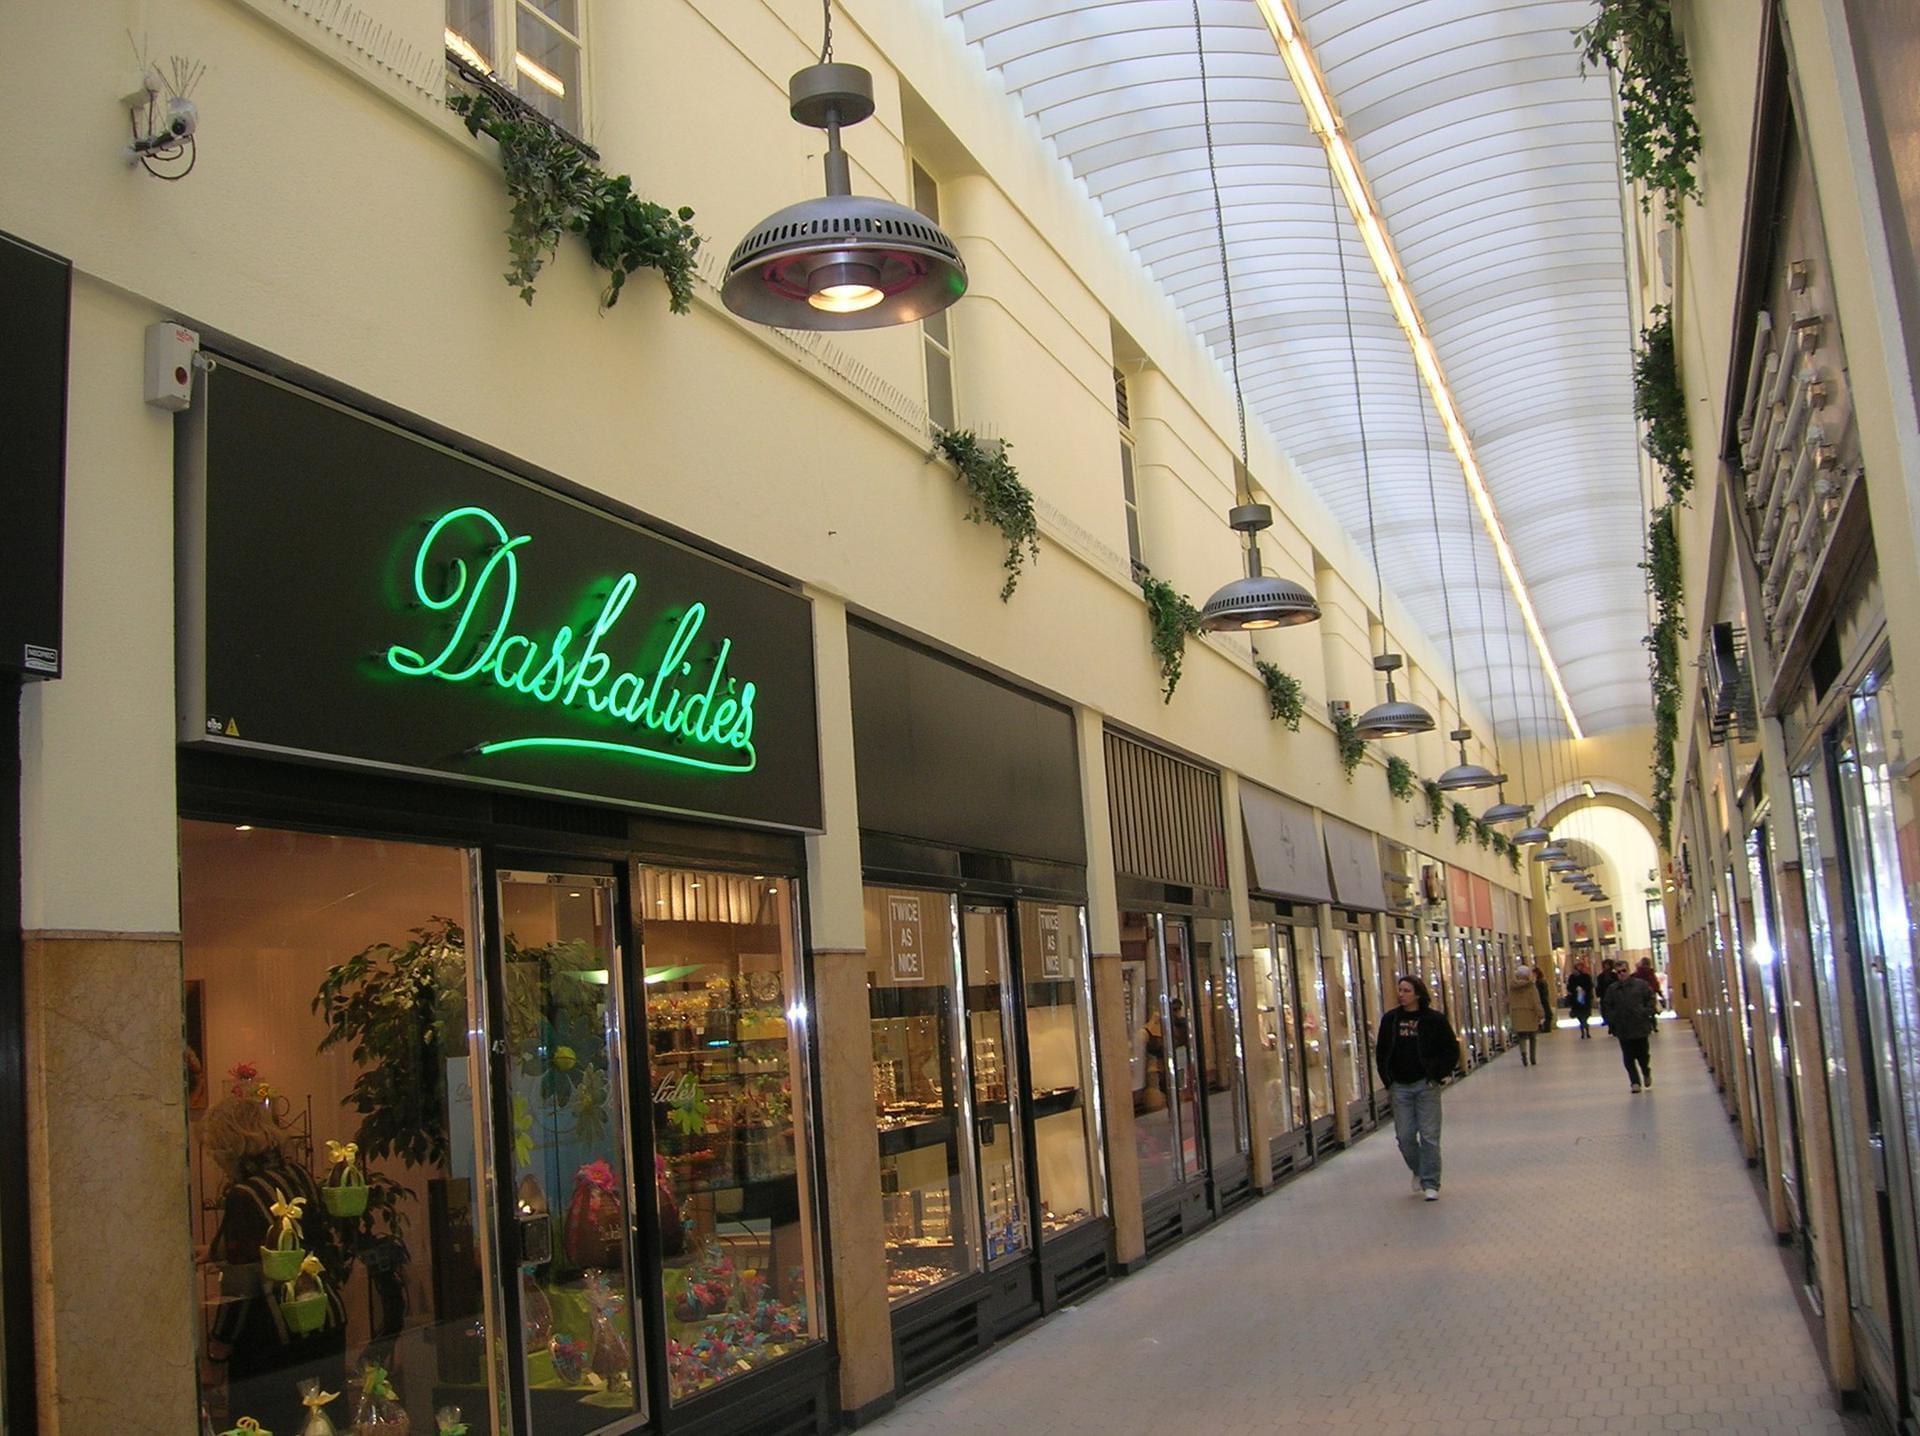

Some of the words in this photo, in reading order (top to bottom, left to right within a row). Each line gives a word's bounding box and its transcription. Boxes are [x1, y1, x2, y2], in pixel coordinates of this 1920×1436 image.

[891, 902, 918, 921] TWICE
[1040, 914, 1059, 930] TWICE
[901, 928, 913, 947] AS
[1047, 935, 1056, 950] AS
[898, 953, 918, 972] NICE
[1046, 955, 1059, 971] NICE
